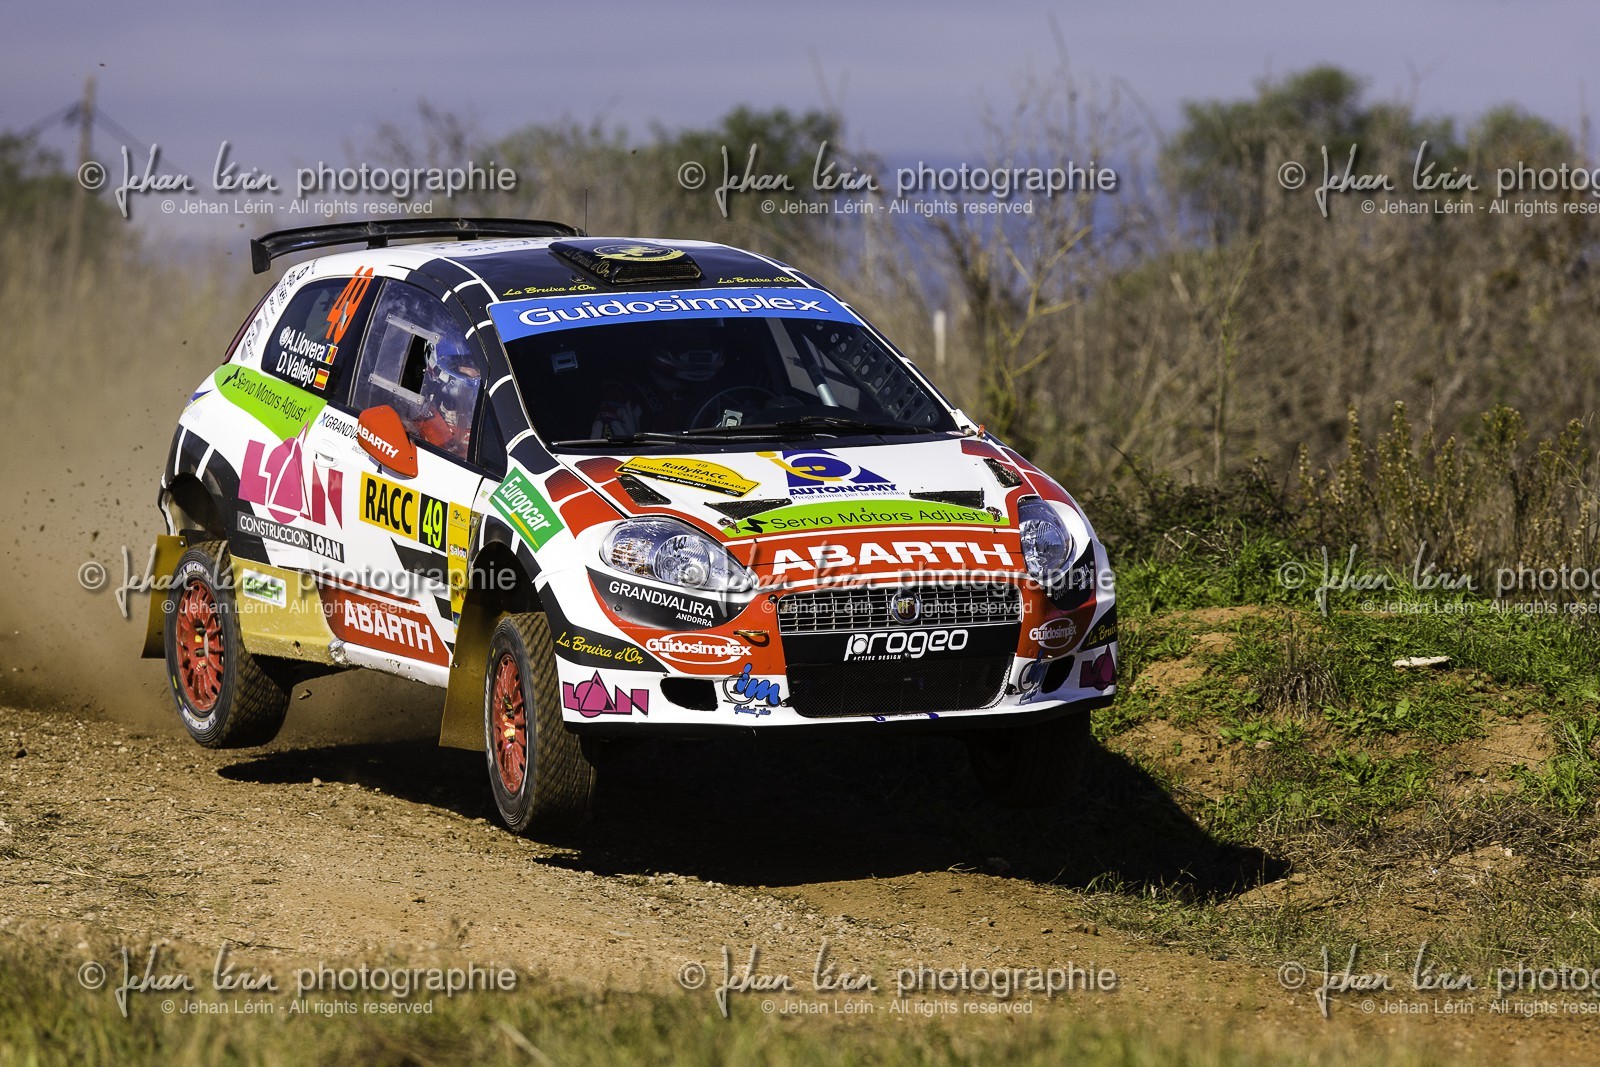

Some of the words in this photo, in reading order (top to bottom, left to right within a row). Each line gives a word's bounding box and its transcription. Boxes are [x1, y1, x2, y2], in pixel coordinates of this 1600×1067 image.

[326, 265, 374, 344] 49
[503, 287, 523, 296] La
[524, 285, 566, 295] Bruixa
[518, 294, 831, 327] Guidosimplex
[286, 328, 326, 361] A.Llovera
[275, 351, 317, 388] D.Vallejo
[232, 372, 256, 396] Servo
[253, 382, 282, 408] Motors
[357, 423, 399, 459] ABARTH
[662, 462, 729, 480] RallyRACC
[365, 477, 413, 535] RACC
[500, 475, 551, 531] Europcar
[789, 484, 896, 496] AUTONOMY
[422, 497, 443, 549] 49
[770, 514, 833, 530] Servo
[838, 509, 912, 524] Motors
[311, 534, 341, 561] LOAN
[772, 541, 1014, 577] ABARTH
[608, 580, 715, 619] GRANDVALIRA
[344, 600, 434, 654] ABARTH
[675, 612, 713, 628] ANDORRA
[1029, 622, 1077, 641] Guidosimplex
[556, 632, 570, 649] La
[572, 635, 613, 659] Bruixa
[614, 646, 645, 665] d'Or
[645, 637, 753, 656] Guidosimplex
[843, 629, 969, 661] progeo
